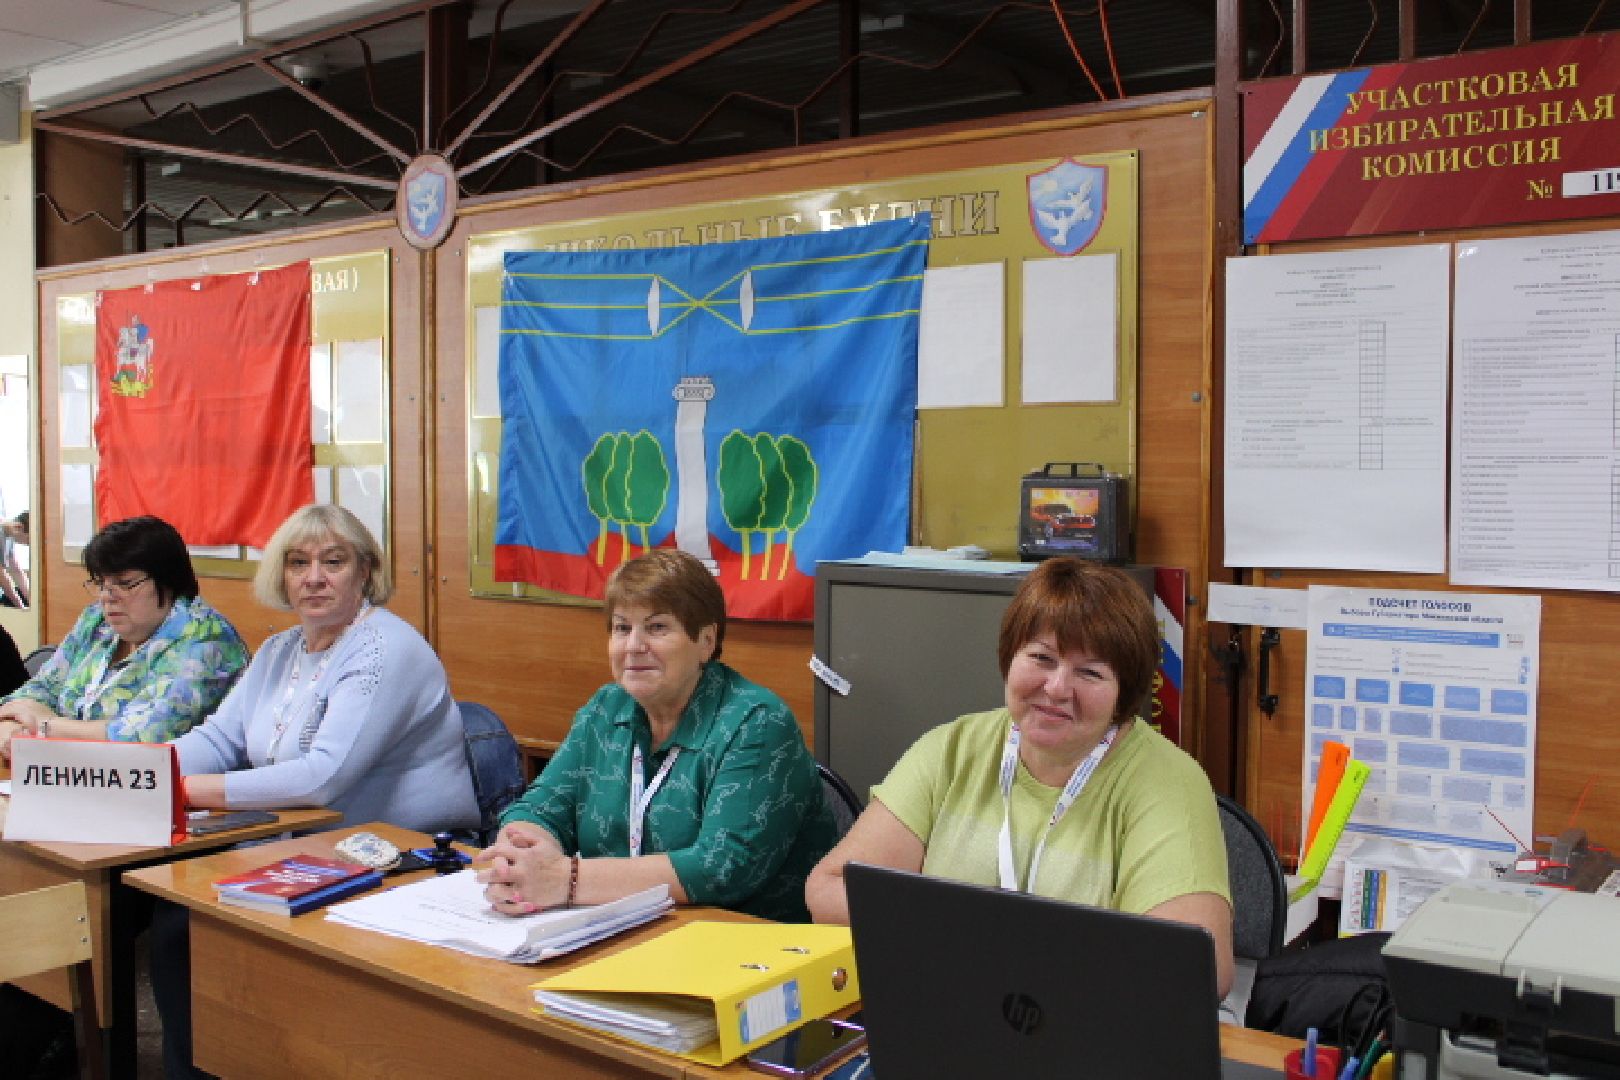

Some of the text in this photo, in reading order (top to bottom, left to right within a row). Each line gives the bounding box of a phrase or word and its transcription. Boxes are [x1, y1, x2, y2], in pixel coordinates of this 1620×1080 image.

[1345, 63, 1580, 115] УЧАСТКОВАЯ
[1309, 93, 1616, 153] ИЗБИРАТЕЛЬНАЯ
[1361, 136, 1562, 181] КОМИССИЯ
[1526, 171, 1620, 201] № 11
[23, 764, 158, 790] ЛЕНИНА 23
